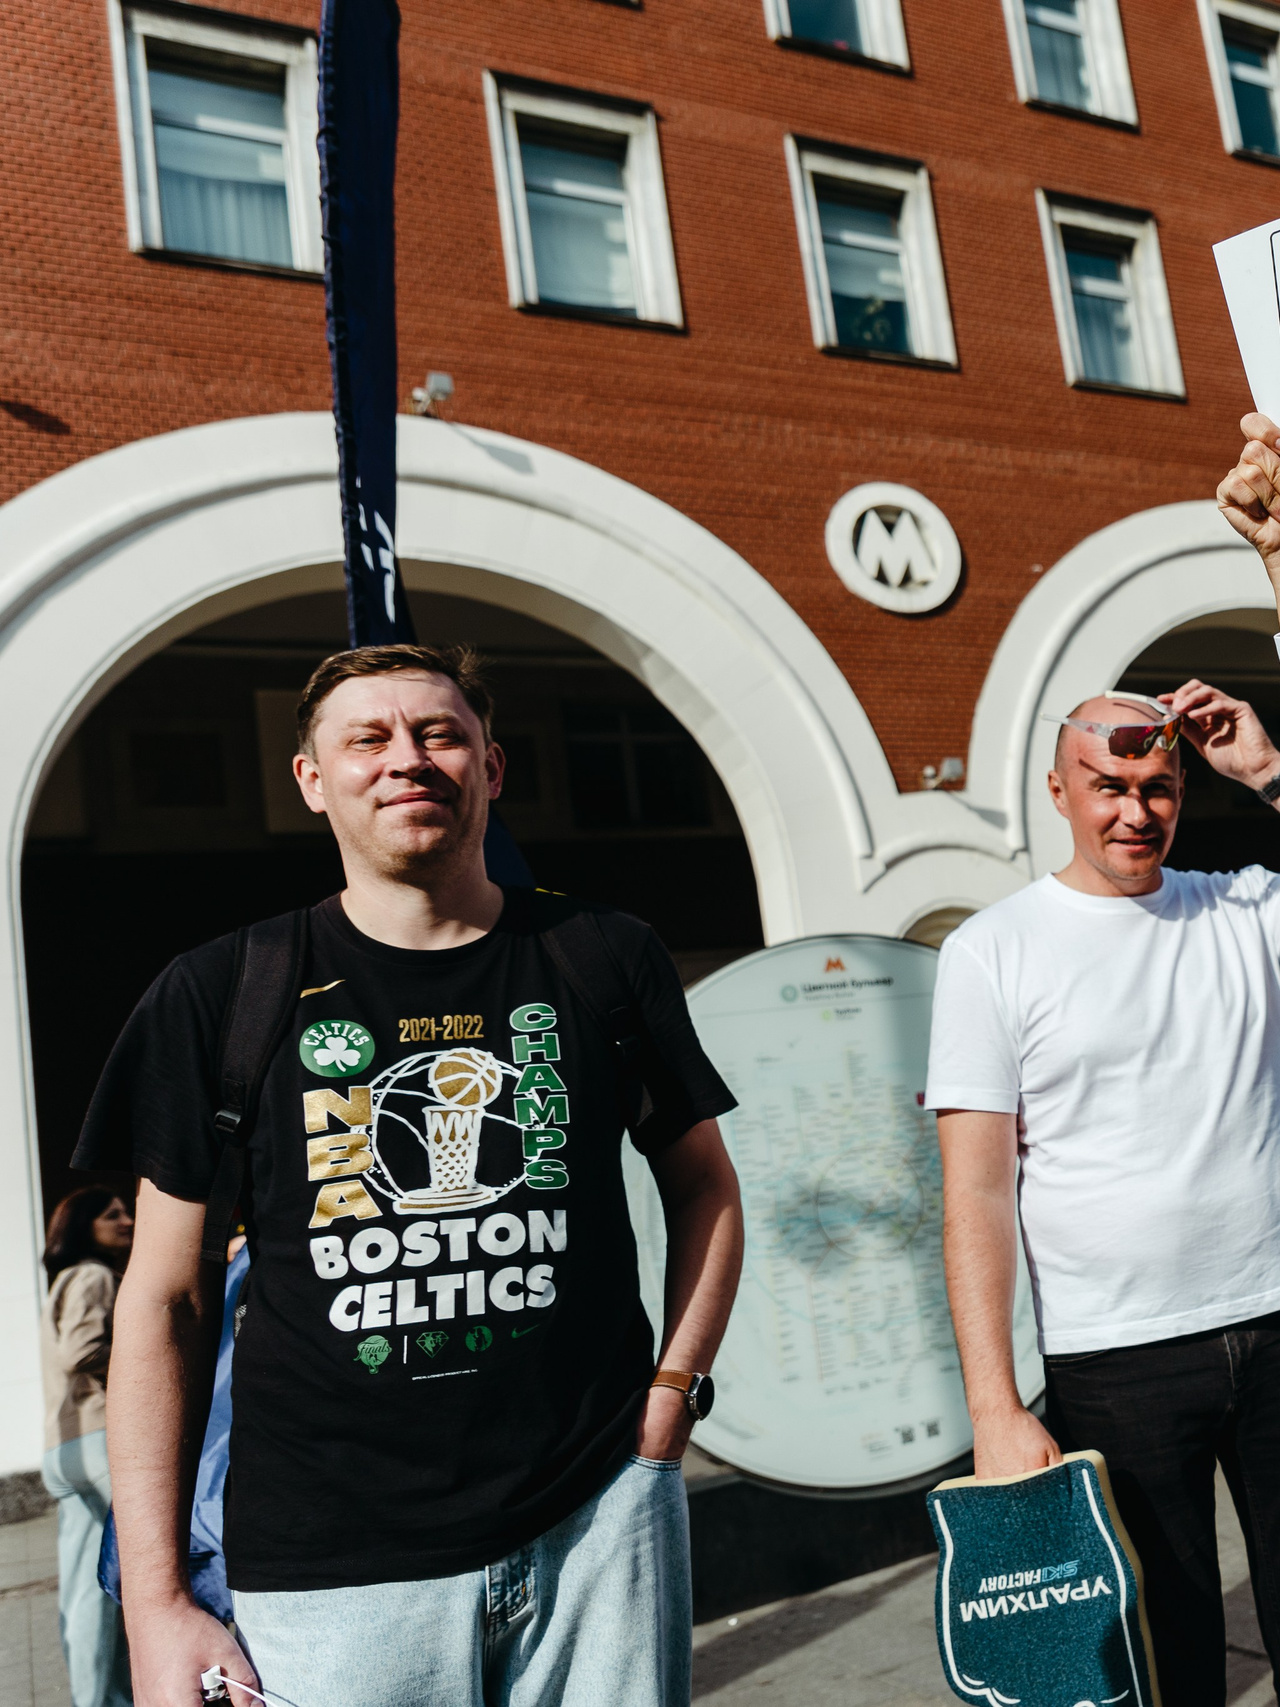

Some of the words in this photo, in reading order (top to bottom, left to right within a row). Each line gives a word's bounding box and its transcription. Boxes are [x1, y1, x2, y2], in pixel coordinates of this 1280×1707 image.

[303, 1022, 370, 1048] CELTICS
[398, 1014, 485, 1043] 2021-2022
[508, 1002, 571, 1190] CHAMPS
[302, 1085, 384, 1229] NBA
[309, 1209, 568, 1281] BOSTON
[328, 1264, 557, 1333] CELTICS
[959, 1575, 1113, 1623] УРАЛХИМ
